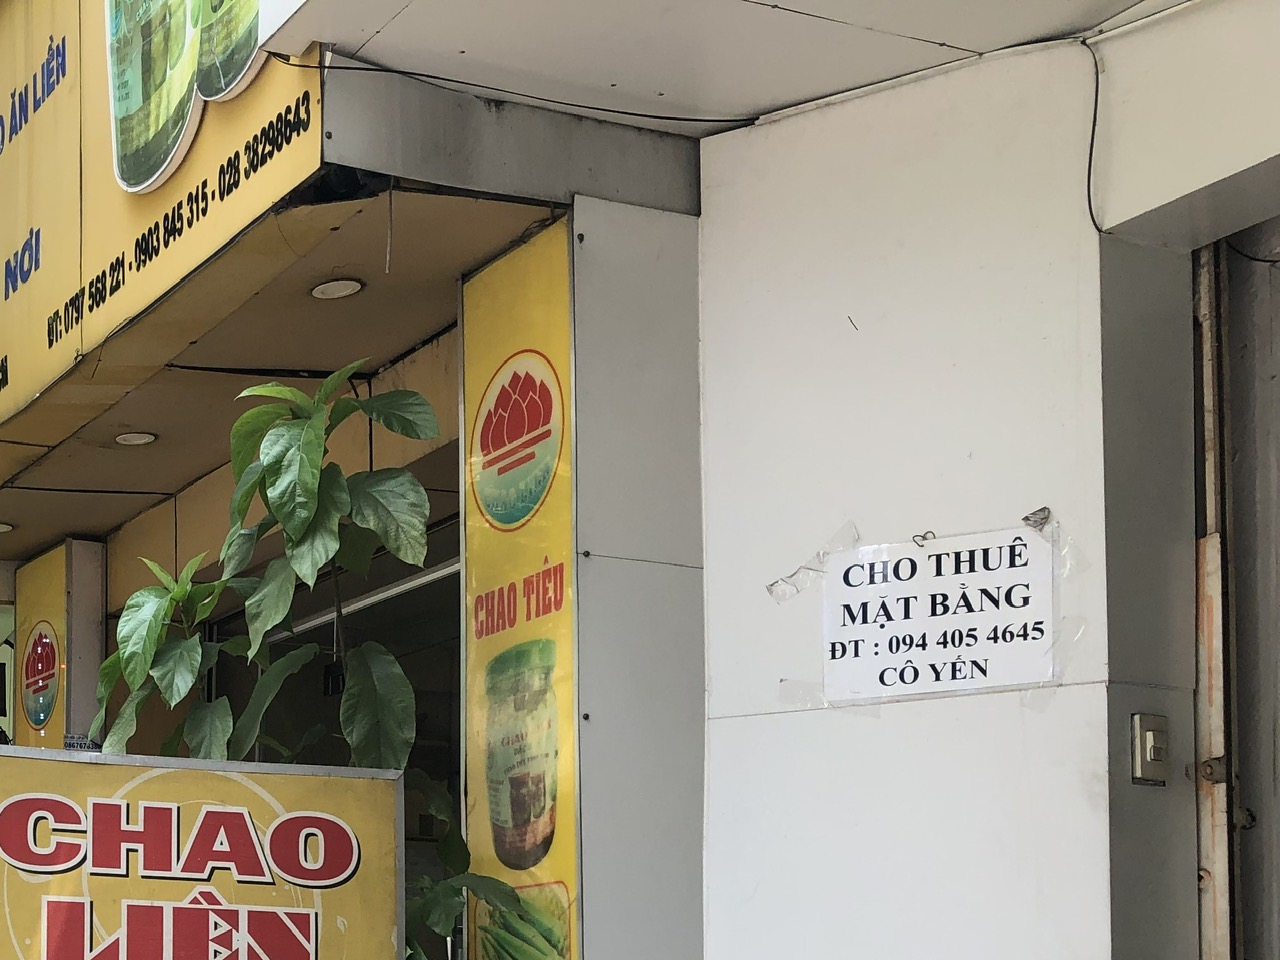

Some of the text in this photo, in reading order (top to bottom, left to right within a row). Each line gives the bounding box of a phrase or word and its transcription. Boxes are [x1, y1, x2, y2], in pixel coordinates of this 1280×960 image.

[9, 83, 29, 143] ĂN
[33, 35, 66, 114] LIỀN
[63, 287, 86, 334] 0797
[87, 269, 107, 313] 568
[108, 251, 126, 298] 221
[134, 221, 161, 272] 0903
[162, 200, 184, 249] 845
[186, 178, 209, 229] 315
[218, 150, 240, 203] 028
[243, 90, 311, 180] 38298643
[5, 227, 40, 301] NƠI
[842, 536, 1029, 588] CHO THUÊ
[474, 555, 564, 640] CHAO TIÊU
[840, 582, 1032, 630] MẶT BẰNG
[888, 632, 928, 655] 094
[936, 627, 978, 650] 405
[986, 621, 1045, 644] 4645
[878, 654, 989, 687] CÔ YẾN
